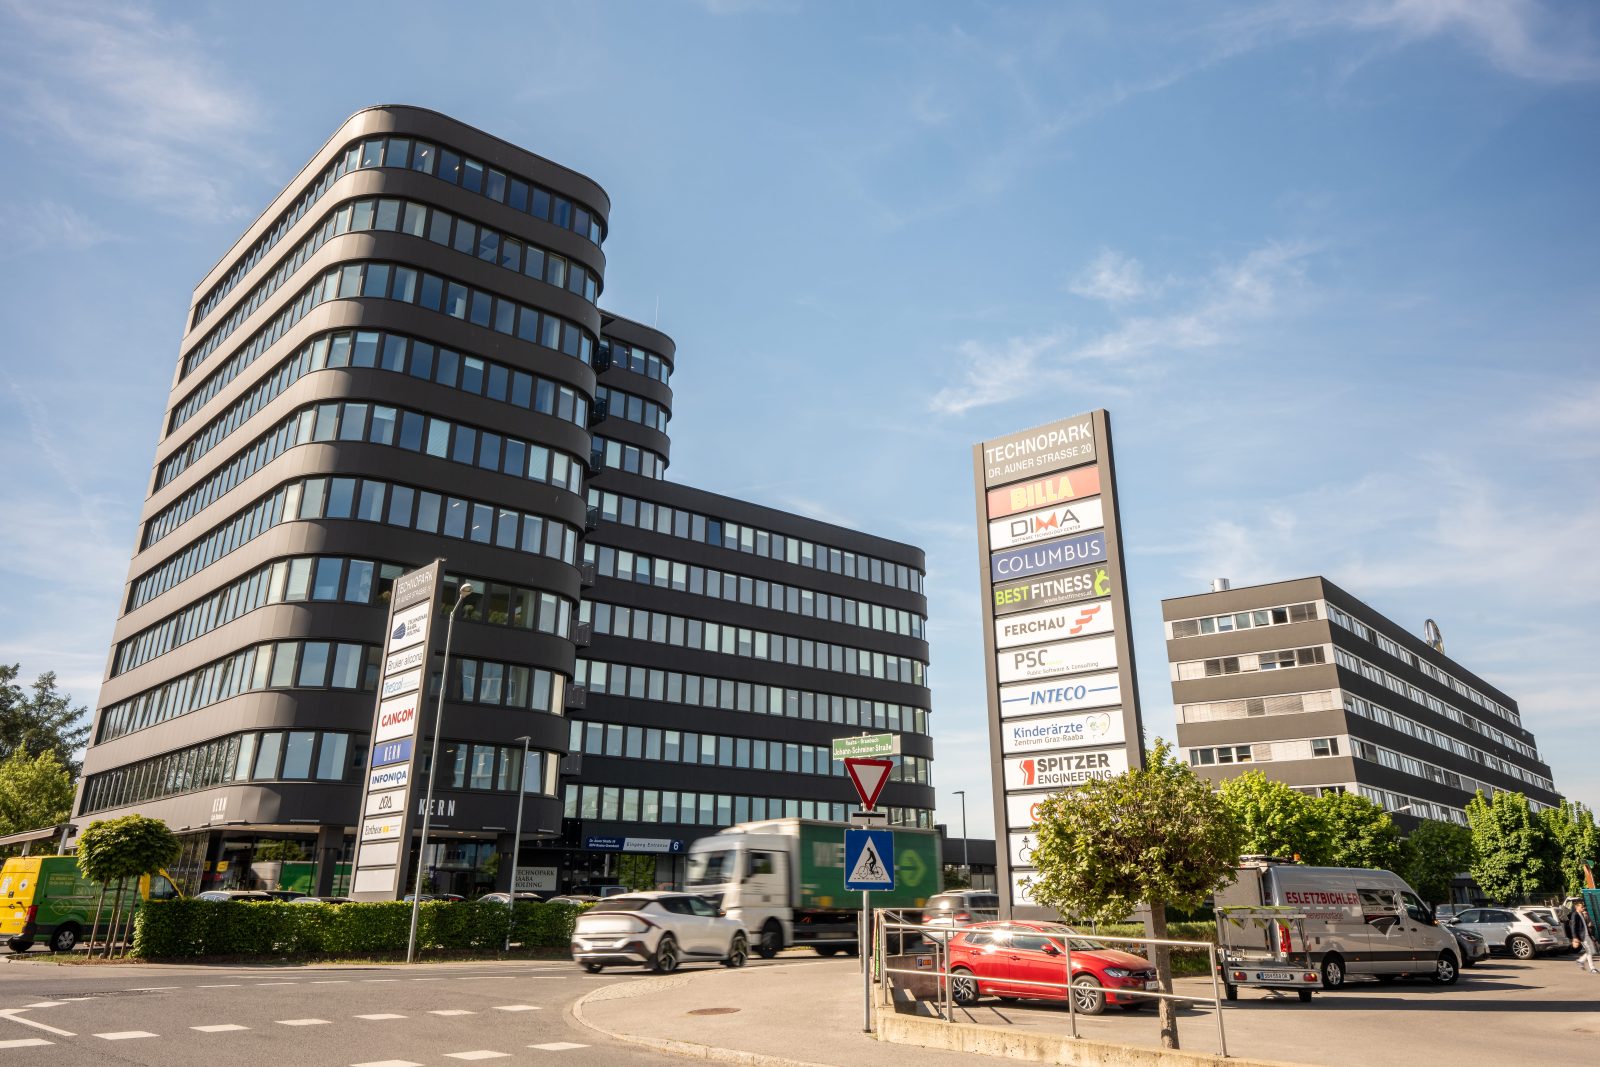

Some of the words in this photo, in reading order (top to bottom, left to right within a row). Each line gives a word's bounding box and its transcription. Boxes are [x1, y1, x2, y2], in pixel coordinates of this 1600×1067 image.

[986, 422, 1091, 463] TECHNOPARK
[988, 468, 1002, 478] DR.
[1004, 458, 1034, 474] AUNER
[1036, 448, 1078, 466] STRASSE
[1081, 443, 1092, 454] 20
[1010, 476, 1074, 511] BILLA
[1011, 509, 1080, 537] DIMA
[1012, 535, 1033, 543] SOFTWARE
[1034, 529, 1063, 539] TECHNOLOGY
[1064, 524, 1081, 533] CENTER
[997, 540, 1101, 574] COLUMBUS
[995, 586, 1029, 606] BEST
[1031, 574, 1092, 600] FITNESS
[1043, 590, 1092, 604] www.bestfitness.at
[1004, 616, 1066, 637] FERCHAU
[1014, 649, 1048, 670] PSC
[1043, 666, 1065, 674] Software
[1071, 661, 1099, 670] Consulting
[1030, 685, 1086, 705] INTECO
[381, 707, 415, 728] CANCOM
[1013, 722, 1083, 739] Kinderärzte
[1014, 737, 1043, 747] Zentrum
[1044, 734, 1084, 744] Graz-Raaba
[383, 744, 401, 762] KERN
[1037, 753, 1110, 773] SPITZER
[371, 770, 407, 785] INFONIQA
[1038, 769, 1112, 785] ENGINEERING
[418, 798, 456, 817] KERN
[673, 841, 679, 851] 6
[1286, 891, 1360, 905] ESLETZBICHLER
